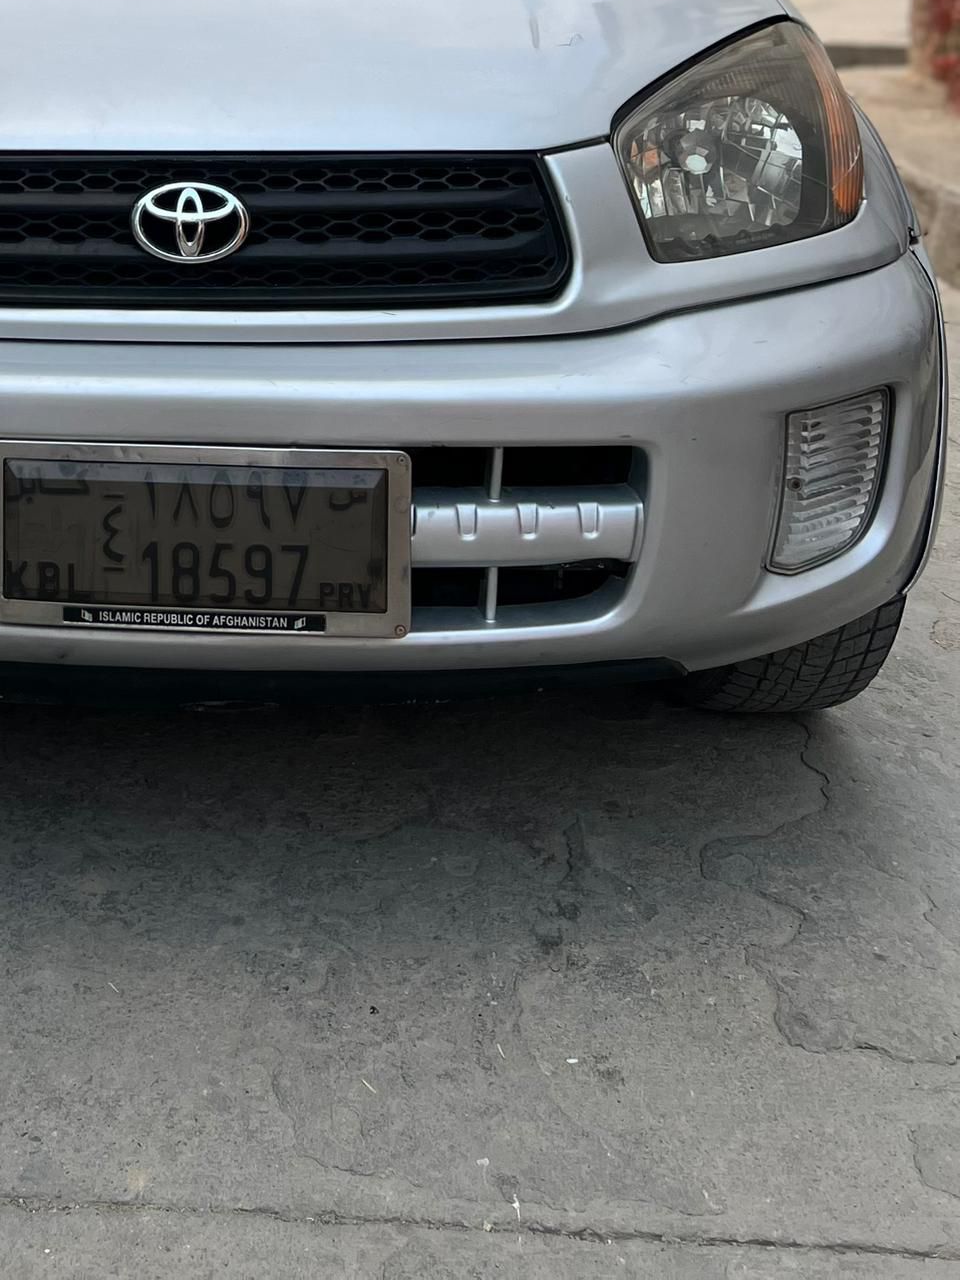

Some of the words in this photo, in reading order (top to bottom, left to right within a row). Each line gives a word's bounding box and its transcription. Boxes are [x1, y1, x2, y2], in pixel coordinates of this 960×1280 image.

[6, 560, 94, 601] KBL
[142, 541, 309, 607] 18597
[319, 582, 372, 608] PRV
[99, 610, 141, 624] ISLAMIC
[143, 612, 194, 625] REPUBLIC
[196, 614, 210, 626] OF
[212, 614, 288, 628] AFGHANISTAN
